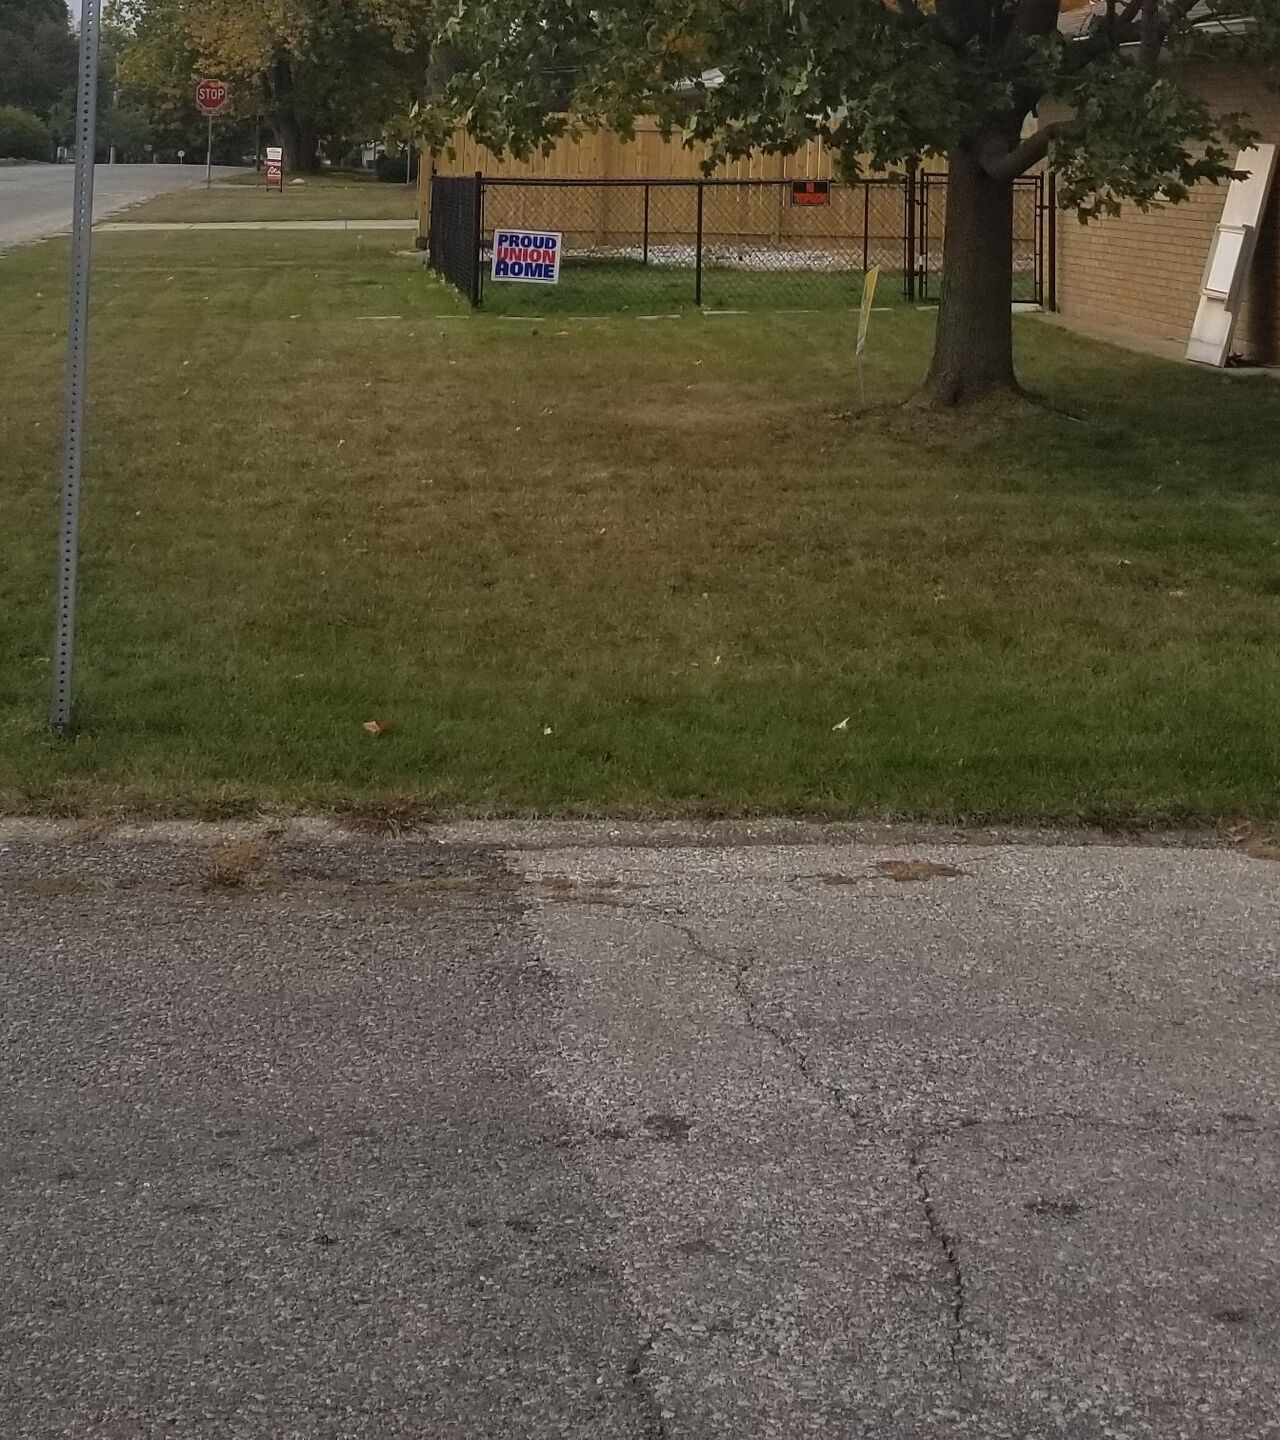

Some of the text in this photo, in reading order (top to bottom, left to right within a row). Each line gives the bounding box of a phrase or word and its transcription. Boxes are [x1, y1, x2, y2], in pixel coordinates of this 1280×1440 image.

[199, 89, 225, 100] STOP
[498, 234, 557, 250] PROUD
[496, 246, 556, 264] UNION
[495, 261, 555, 279] HOME
